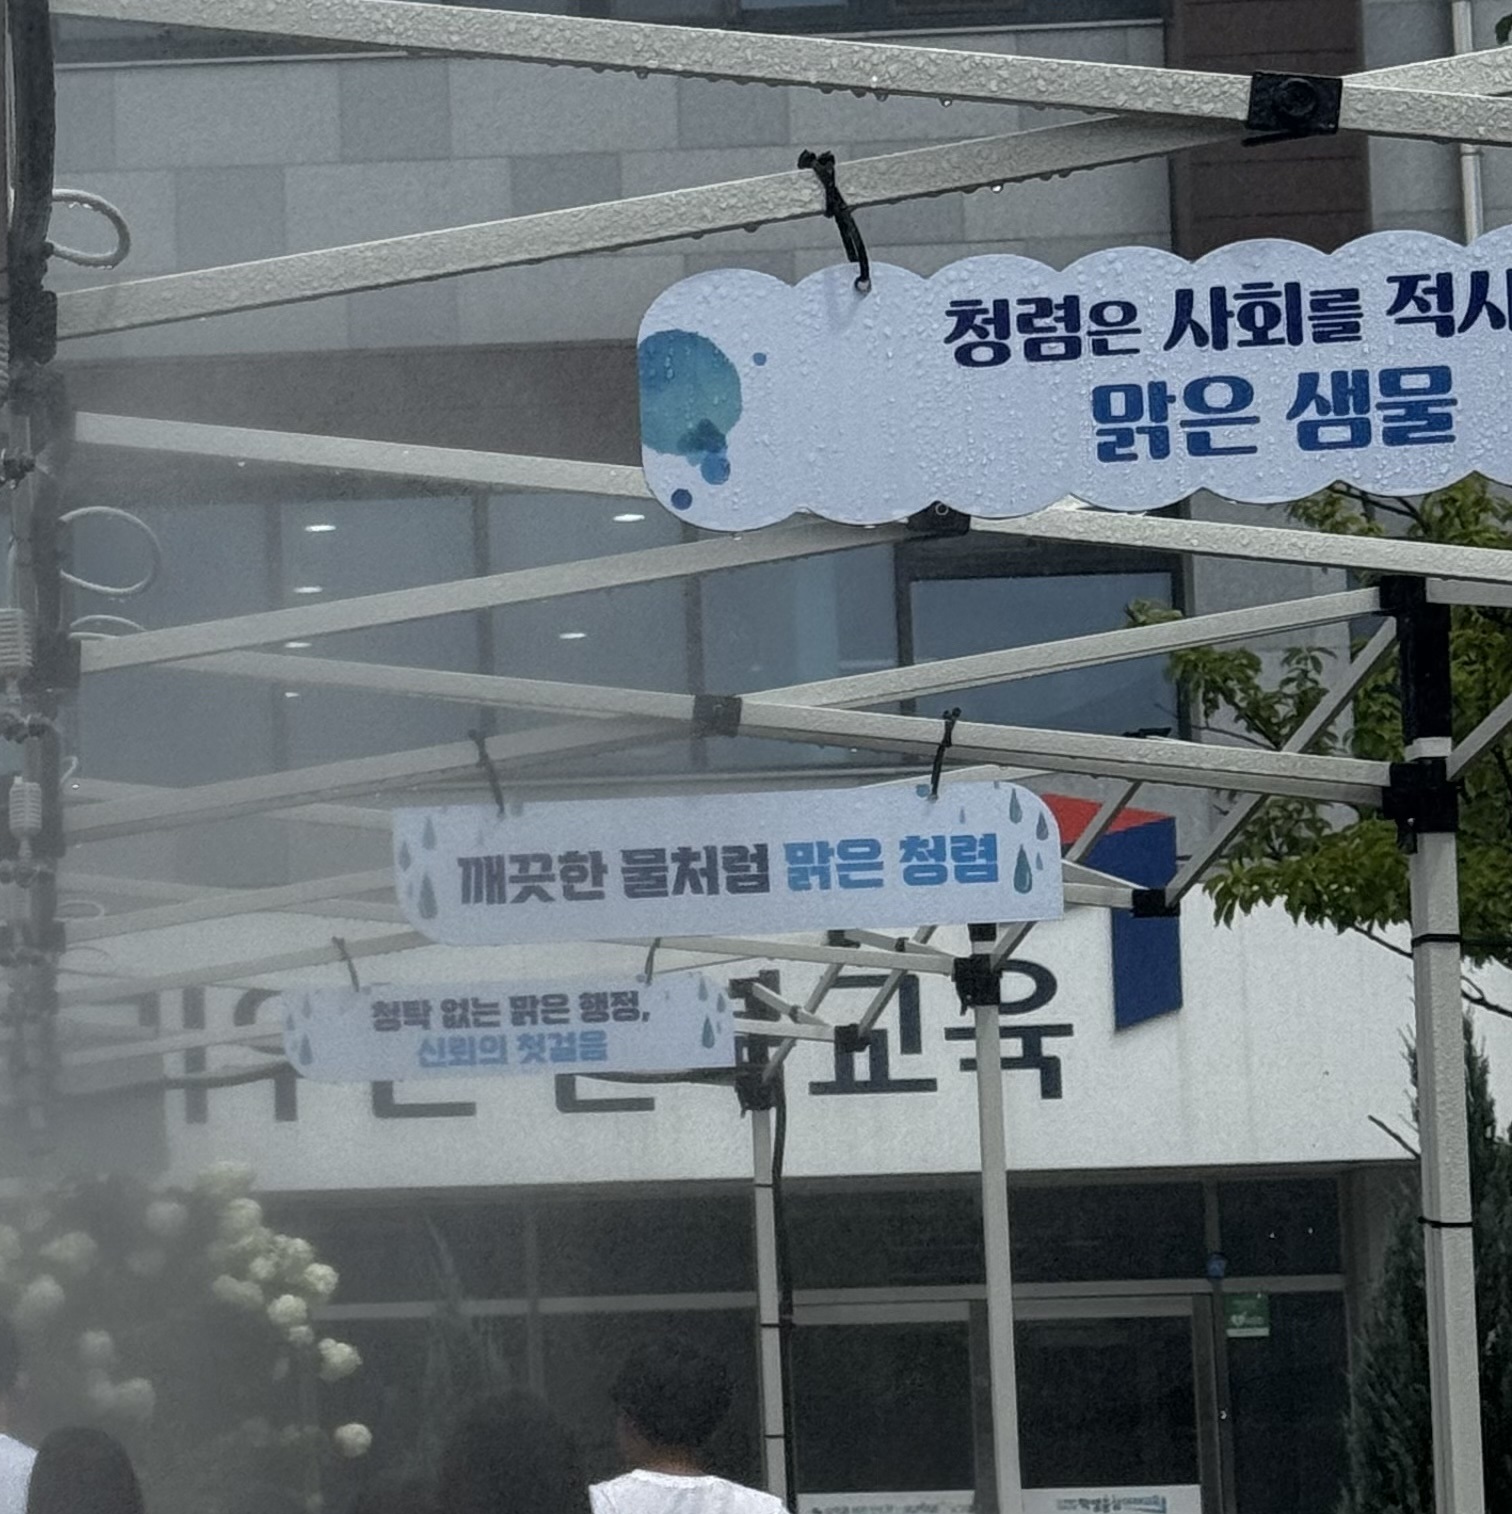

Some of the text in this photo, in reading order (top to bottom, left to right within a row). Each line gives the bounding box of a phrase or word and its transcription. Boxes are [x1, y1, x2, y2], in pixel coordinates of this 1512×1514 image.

[945, 296, 1142, 367] 청렴은
[1163, 281, 1364, 352] 사회를
[1093, 365, 1458, 463] 맑은 샘물
[458, 832, 999, 906] 깨끗한 물처럼 맑은 청렴
[372, 999, 432, 1032] 청탁
[441, 997, 501, 1029] 없는
[578, 989, 650, 1024] 행정,
[419, 1029, 609, 1068] 신뢰의 첫걸음
